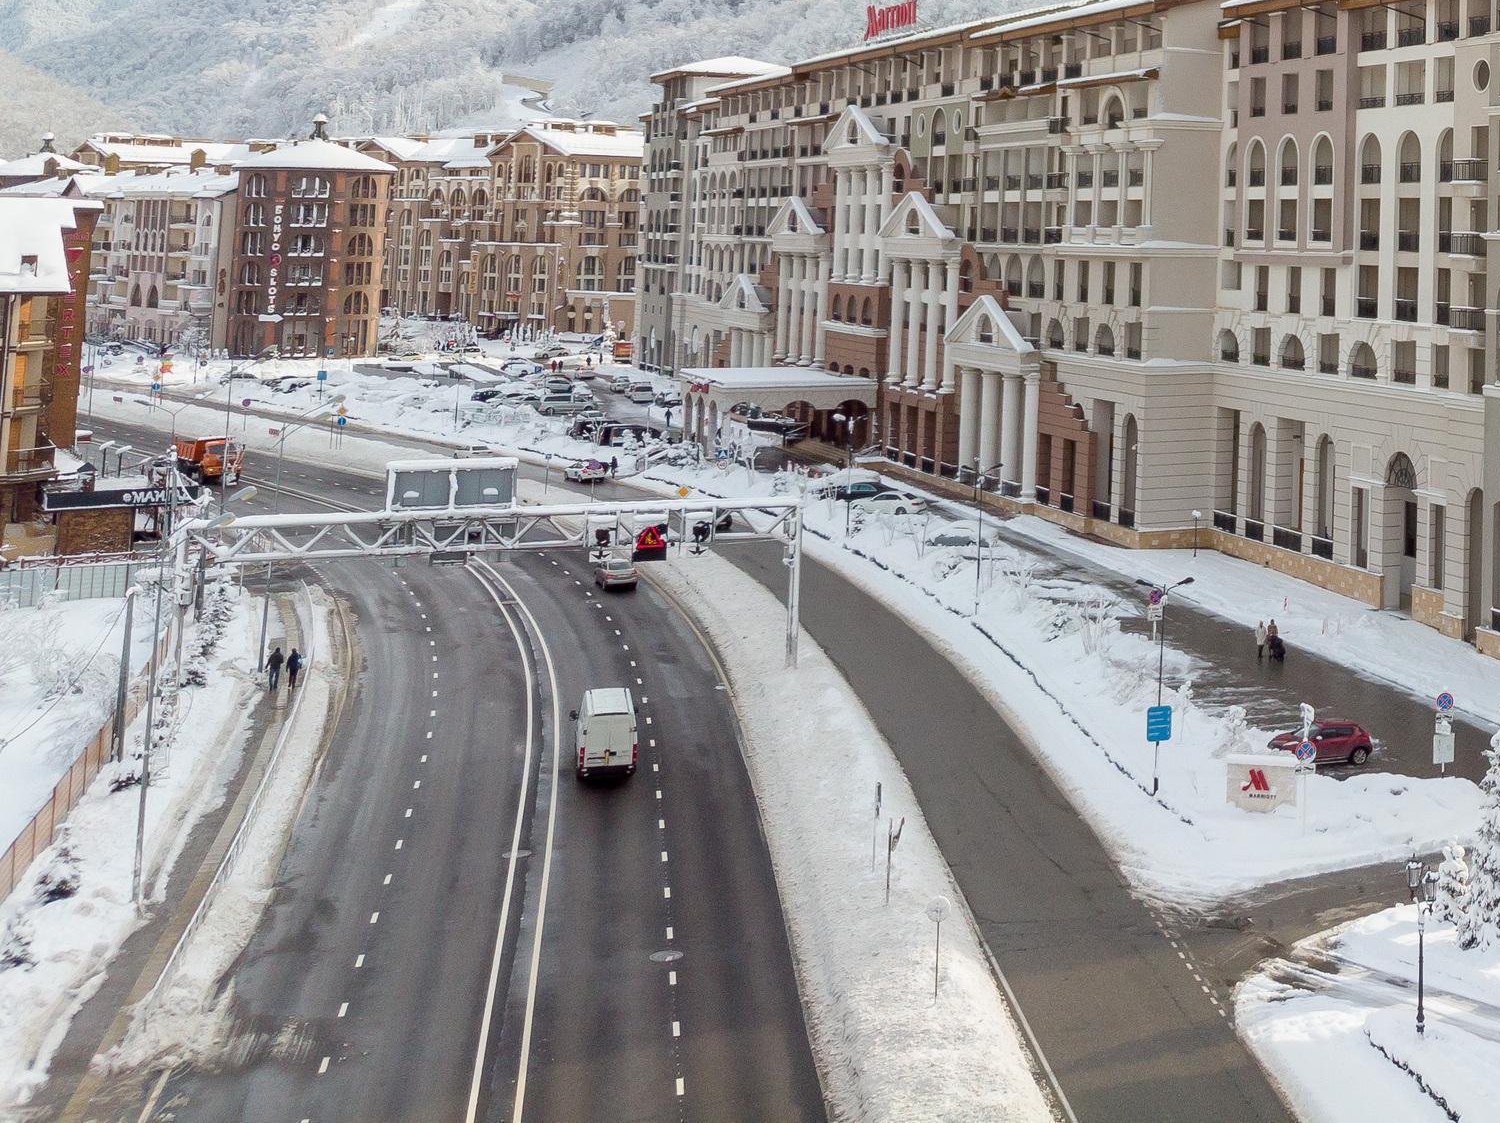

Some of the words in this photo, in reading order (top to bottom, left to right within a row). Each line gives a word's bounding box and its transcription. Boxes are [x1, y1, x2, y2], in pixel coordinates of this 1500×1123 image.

[271, 205, 284, 251] БОНУС
[267, 268, 278, 314] SLOTS
[57, 270, 80, 376] VERTEX
